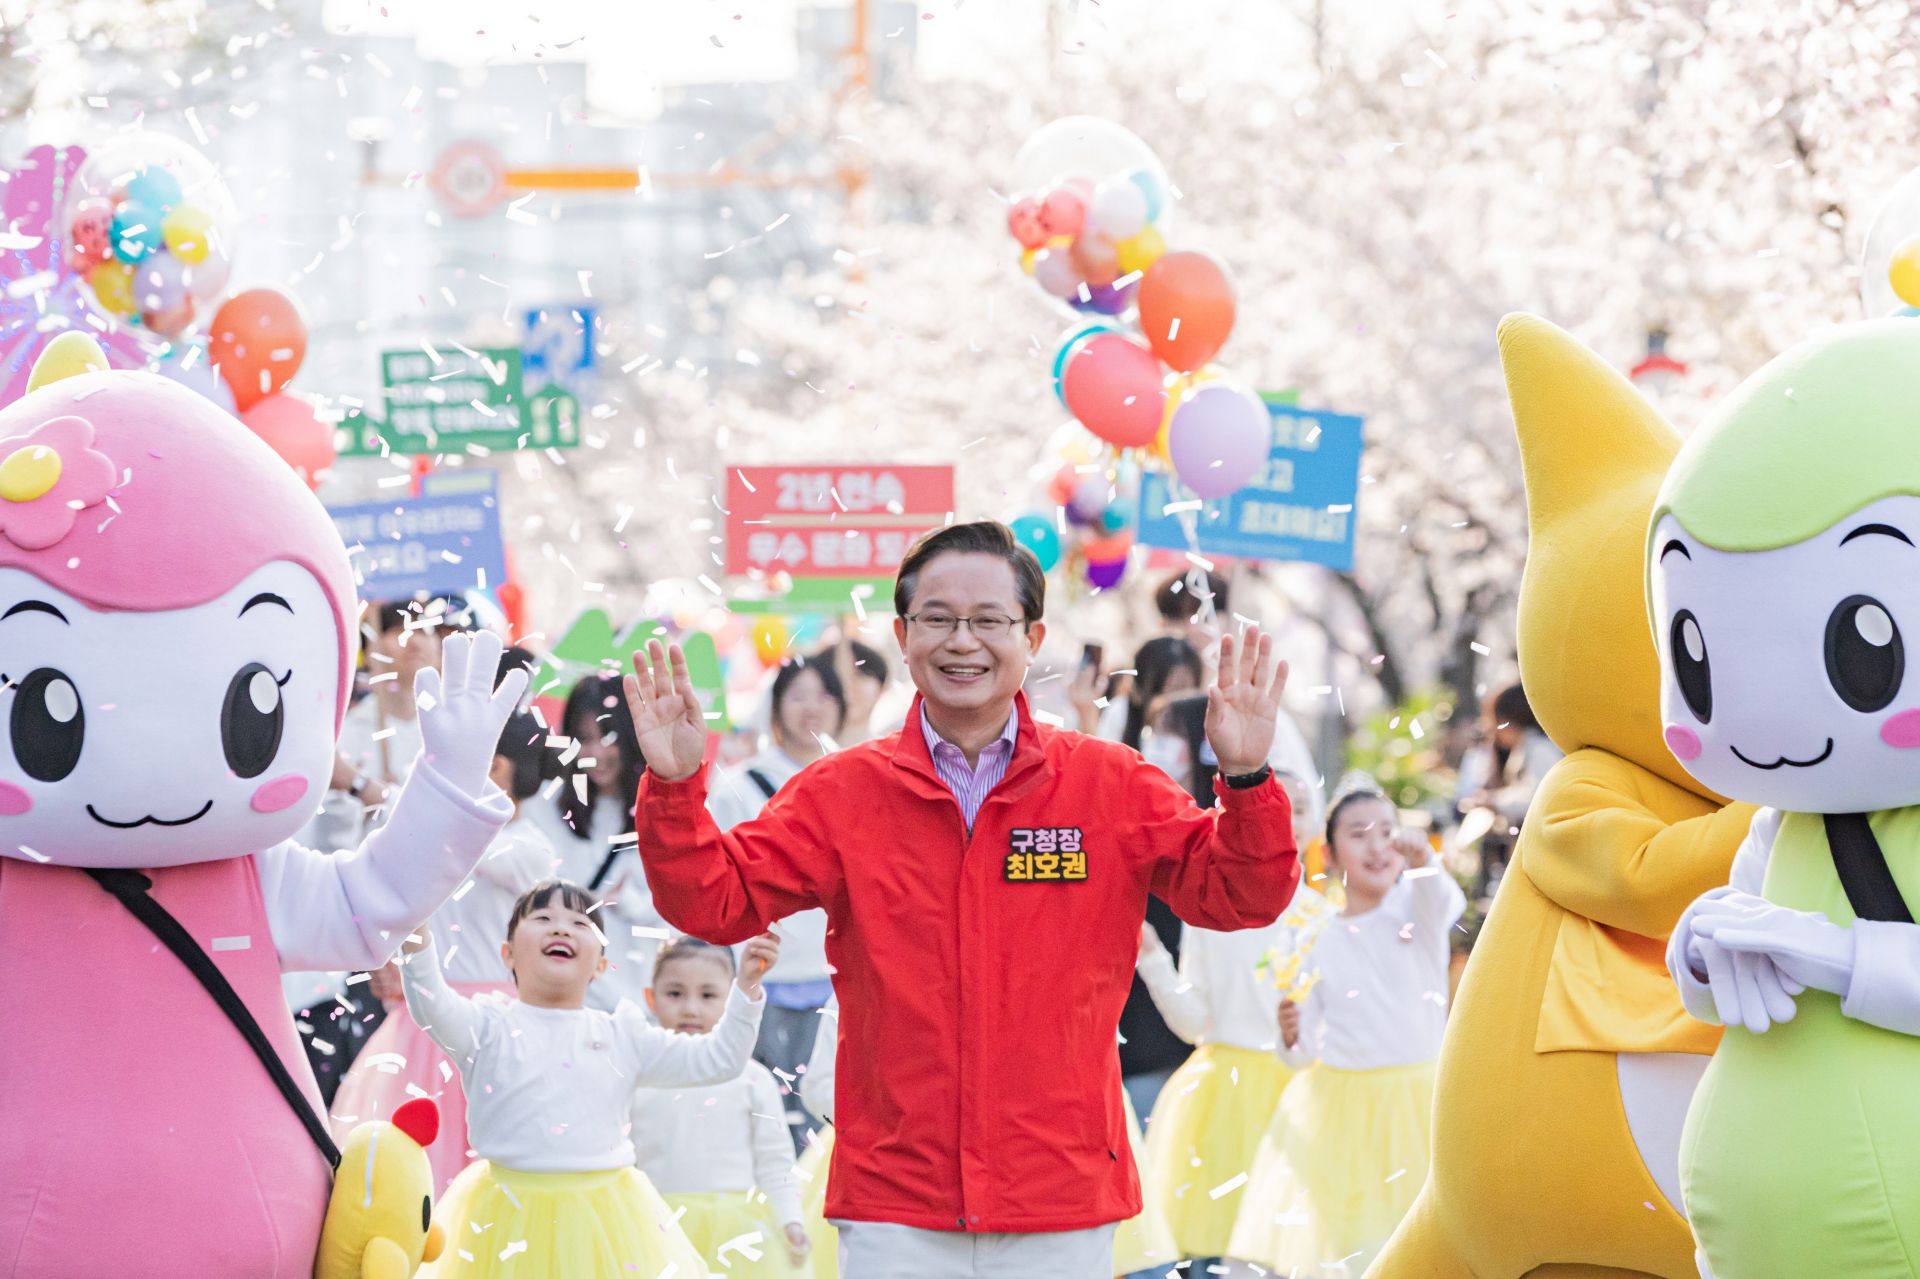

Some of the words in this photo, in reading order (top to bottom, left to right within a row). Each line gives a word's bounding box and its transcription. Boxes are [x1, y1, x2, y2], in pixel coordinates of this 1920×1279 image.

[776, 472, 832, 511] 2년
[1011, 828, 1082, 853] 구청장
[1007, 852, 1087, 880] 최호권
